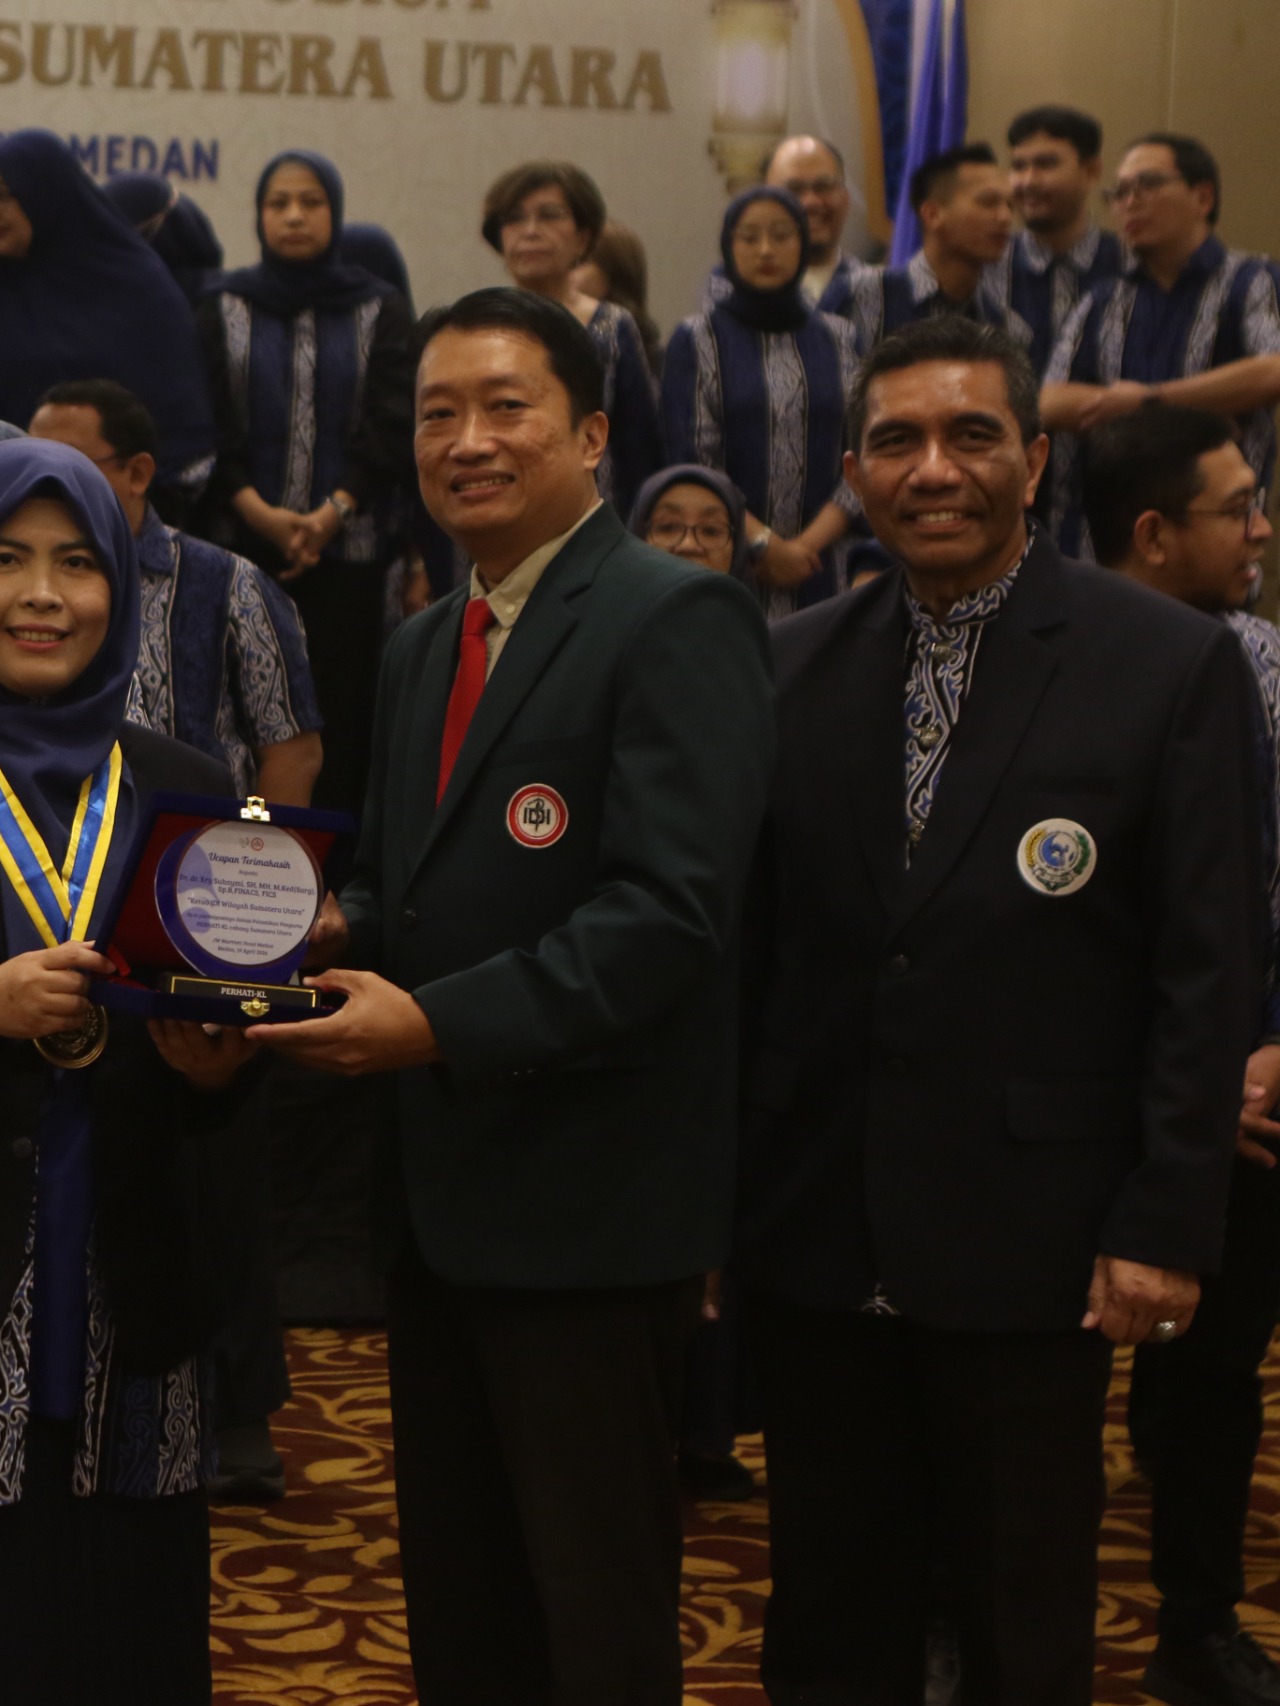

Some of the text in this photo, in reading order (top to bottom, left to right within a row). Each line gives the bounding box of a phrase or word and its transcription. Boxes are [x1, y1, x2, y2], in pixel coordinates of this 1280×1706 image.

[423, 38, 673, 113] UTARA
[70, 133, 219, 181] MEDAN
[209, 852, 292, 870] Ucapan Terimakasih
[221, 901, 249, 910] Wilayah
[250, 904, 282, 914] Sumatera
[220, 987, 267, 999] PERHATI-KL
